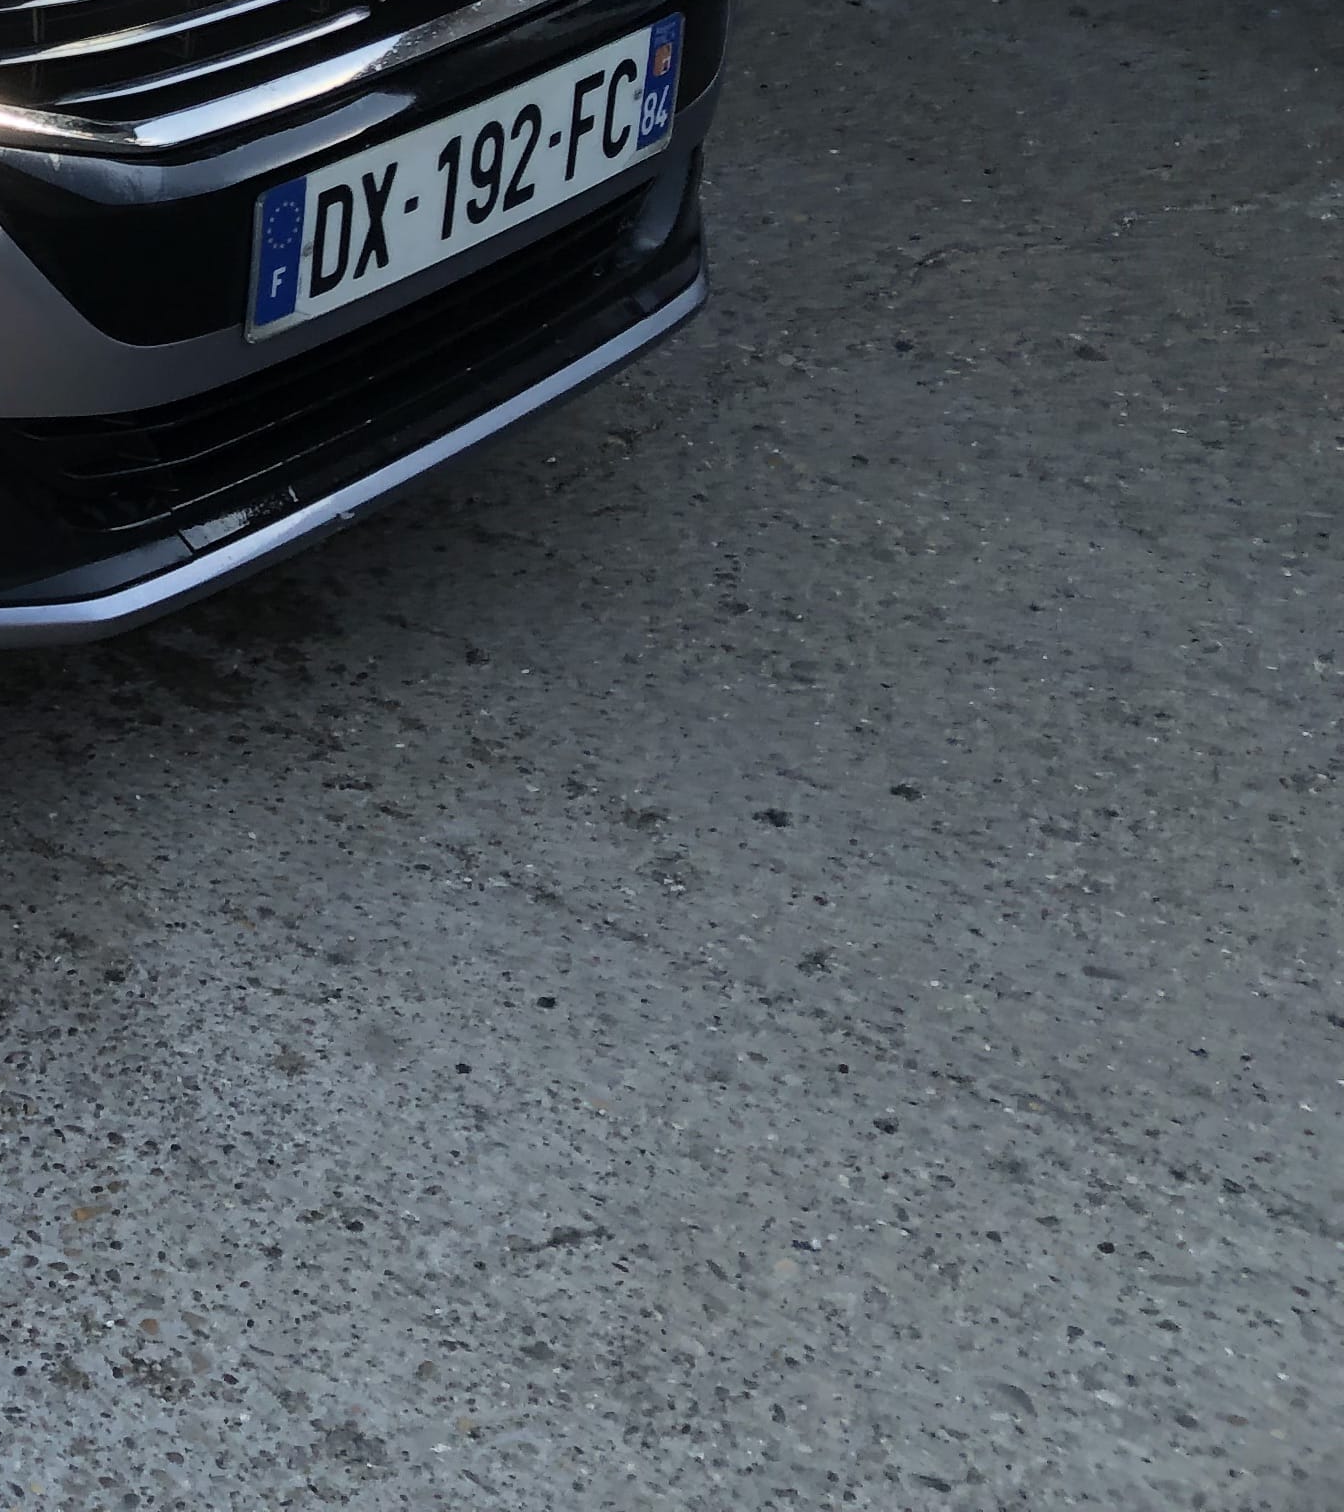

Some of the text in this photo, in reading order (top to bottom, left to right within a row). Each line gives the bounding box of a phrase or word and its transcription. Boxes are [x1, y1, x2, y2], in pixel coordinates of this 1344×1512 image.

[640, 84, 670, 136] 84
[309, 58, 638, 299] DX-192-FC
[270, 265, 287, 299] F
